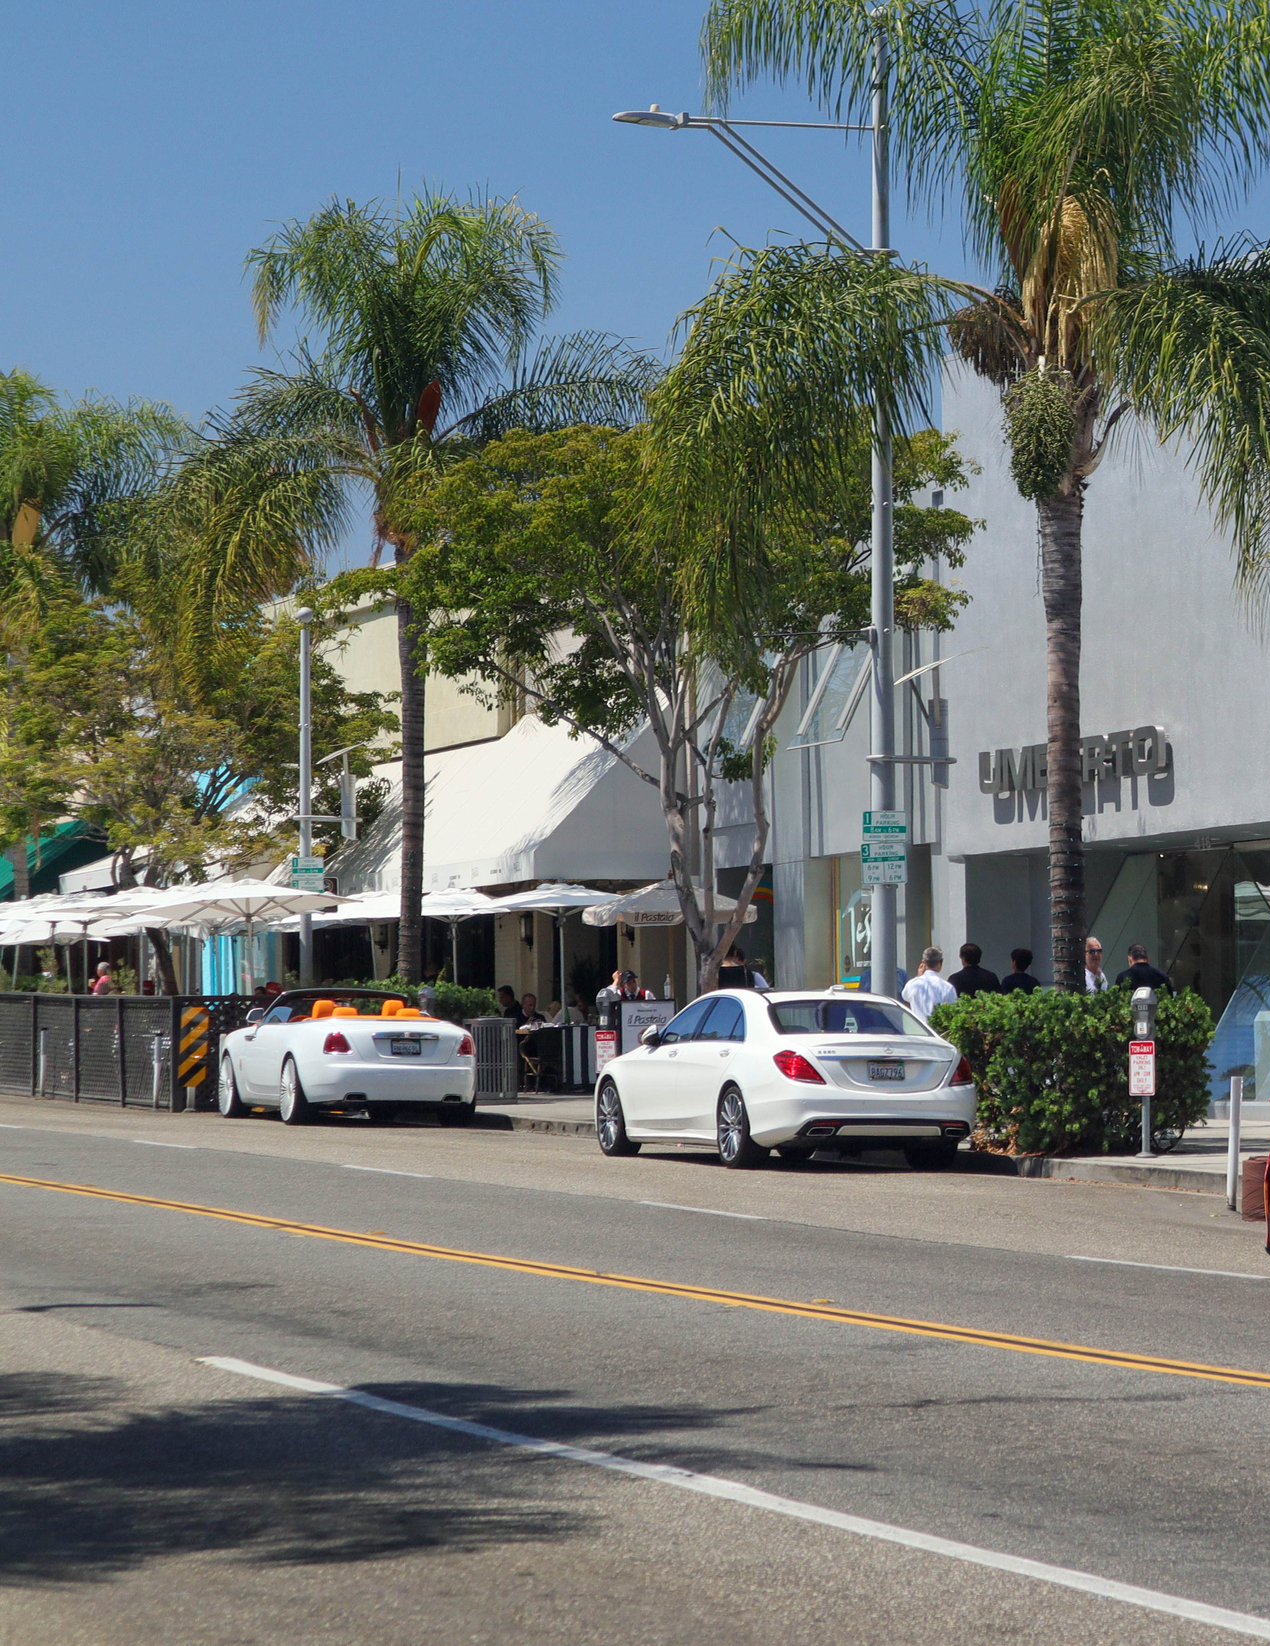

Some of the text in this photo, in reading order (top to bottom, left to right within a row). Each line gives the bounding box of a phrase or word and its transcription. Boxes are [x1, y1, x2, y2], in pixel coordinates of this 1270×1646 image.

[979, 725, 1167, 794] UMBRTO
[865, 813, 870, 824] 1
[862, 845, 869, 856] 3
[641, 912, 675, 922] Pastaio
[633, 1014, 667, 1025] Pastaio
